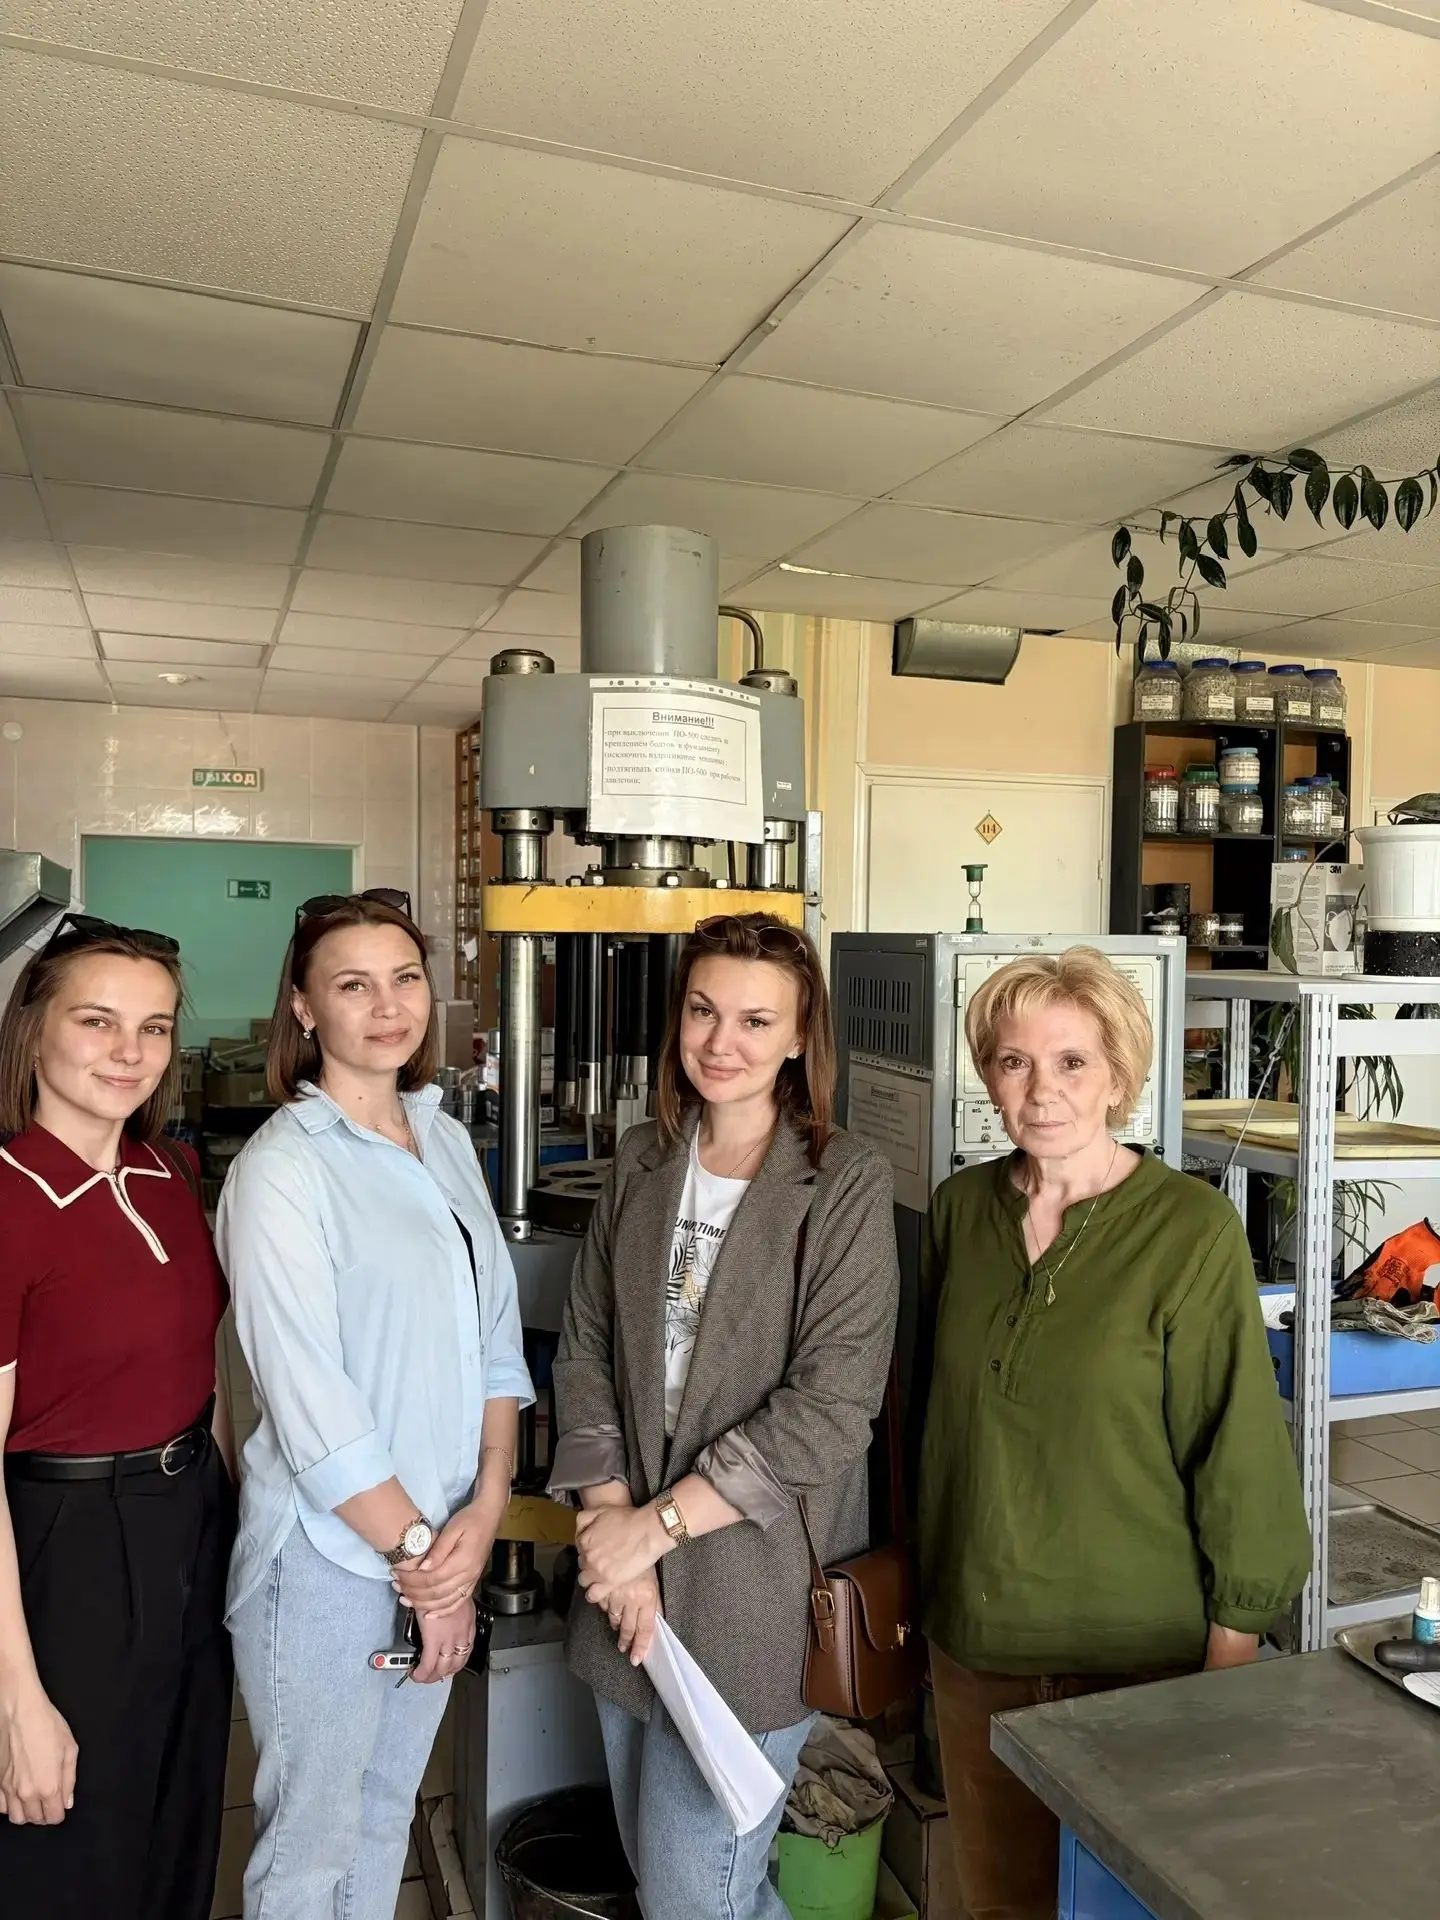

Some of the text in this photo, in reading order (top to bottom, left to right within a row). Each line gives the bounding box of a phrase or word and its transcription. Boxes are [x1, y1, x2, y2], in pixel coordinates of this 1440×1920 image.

[652, 711, 715, 727] Внимание!!!
[194, 771, 256, 786] ВЫХОД
[1329, 865, 1342, 874] 3M
[697, 1221, 727, 1239] TIME
